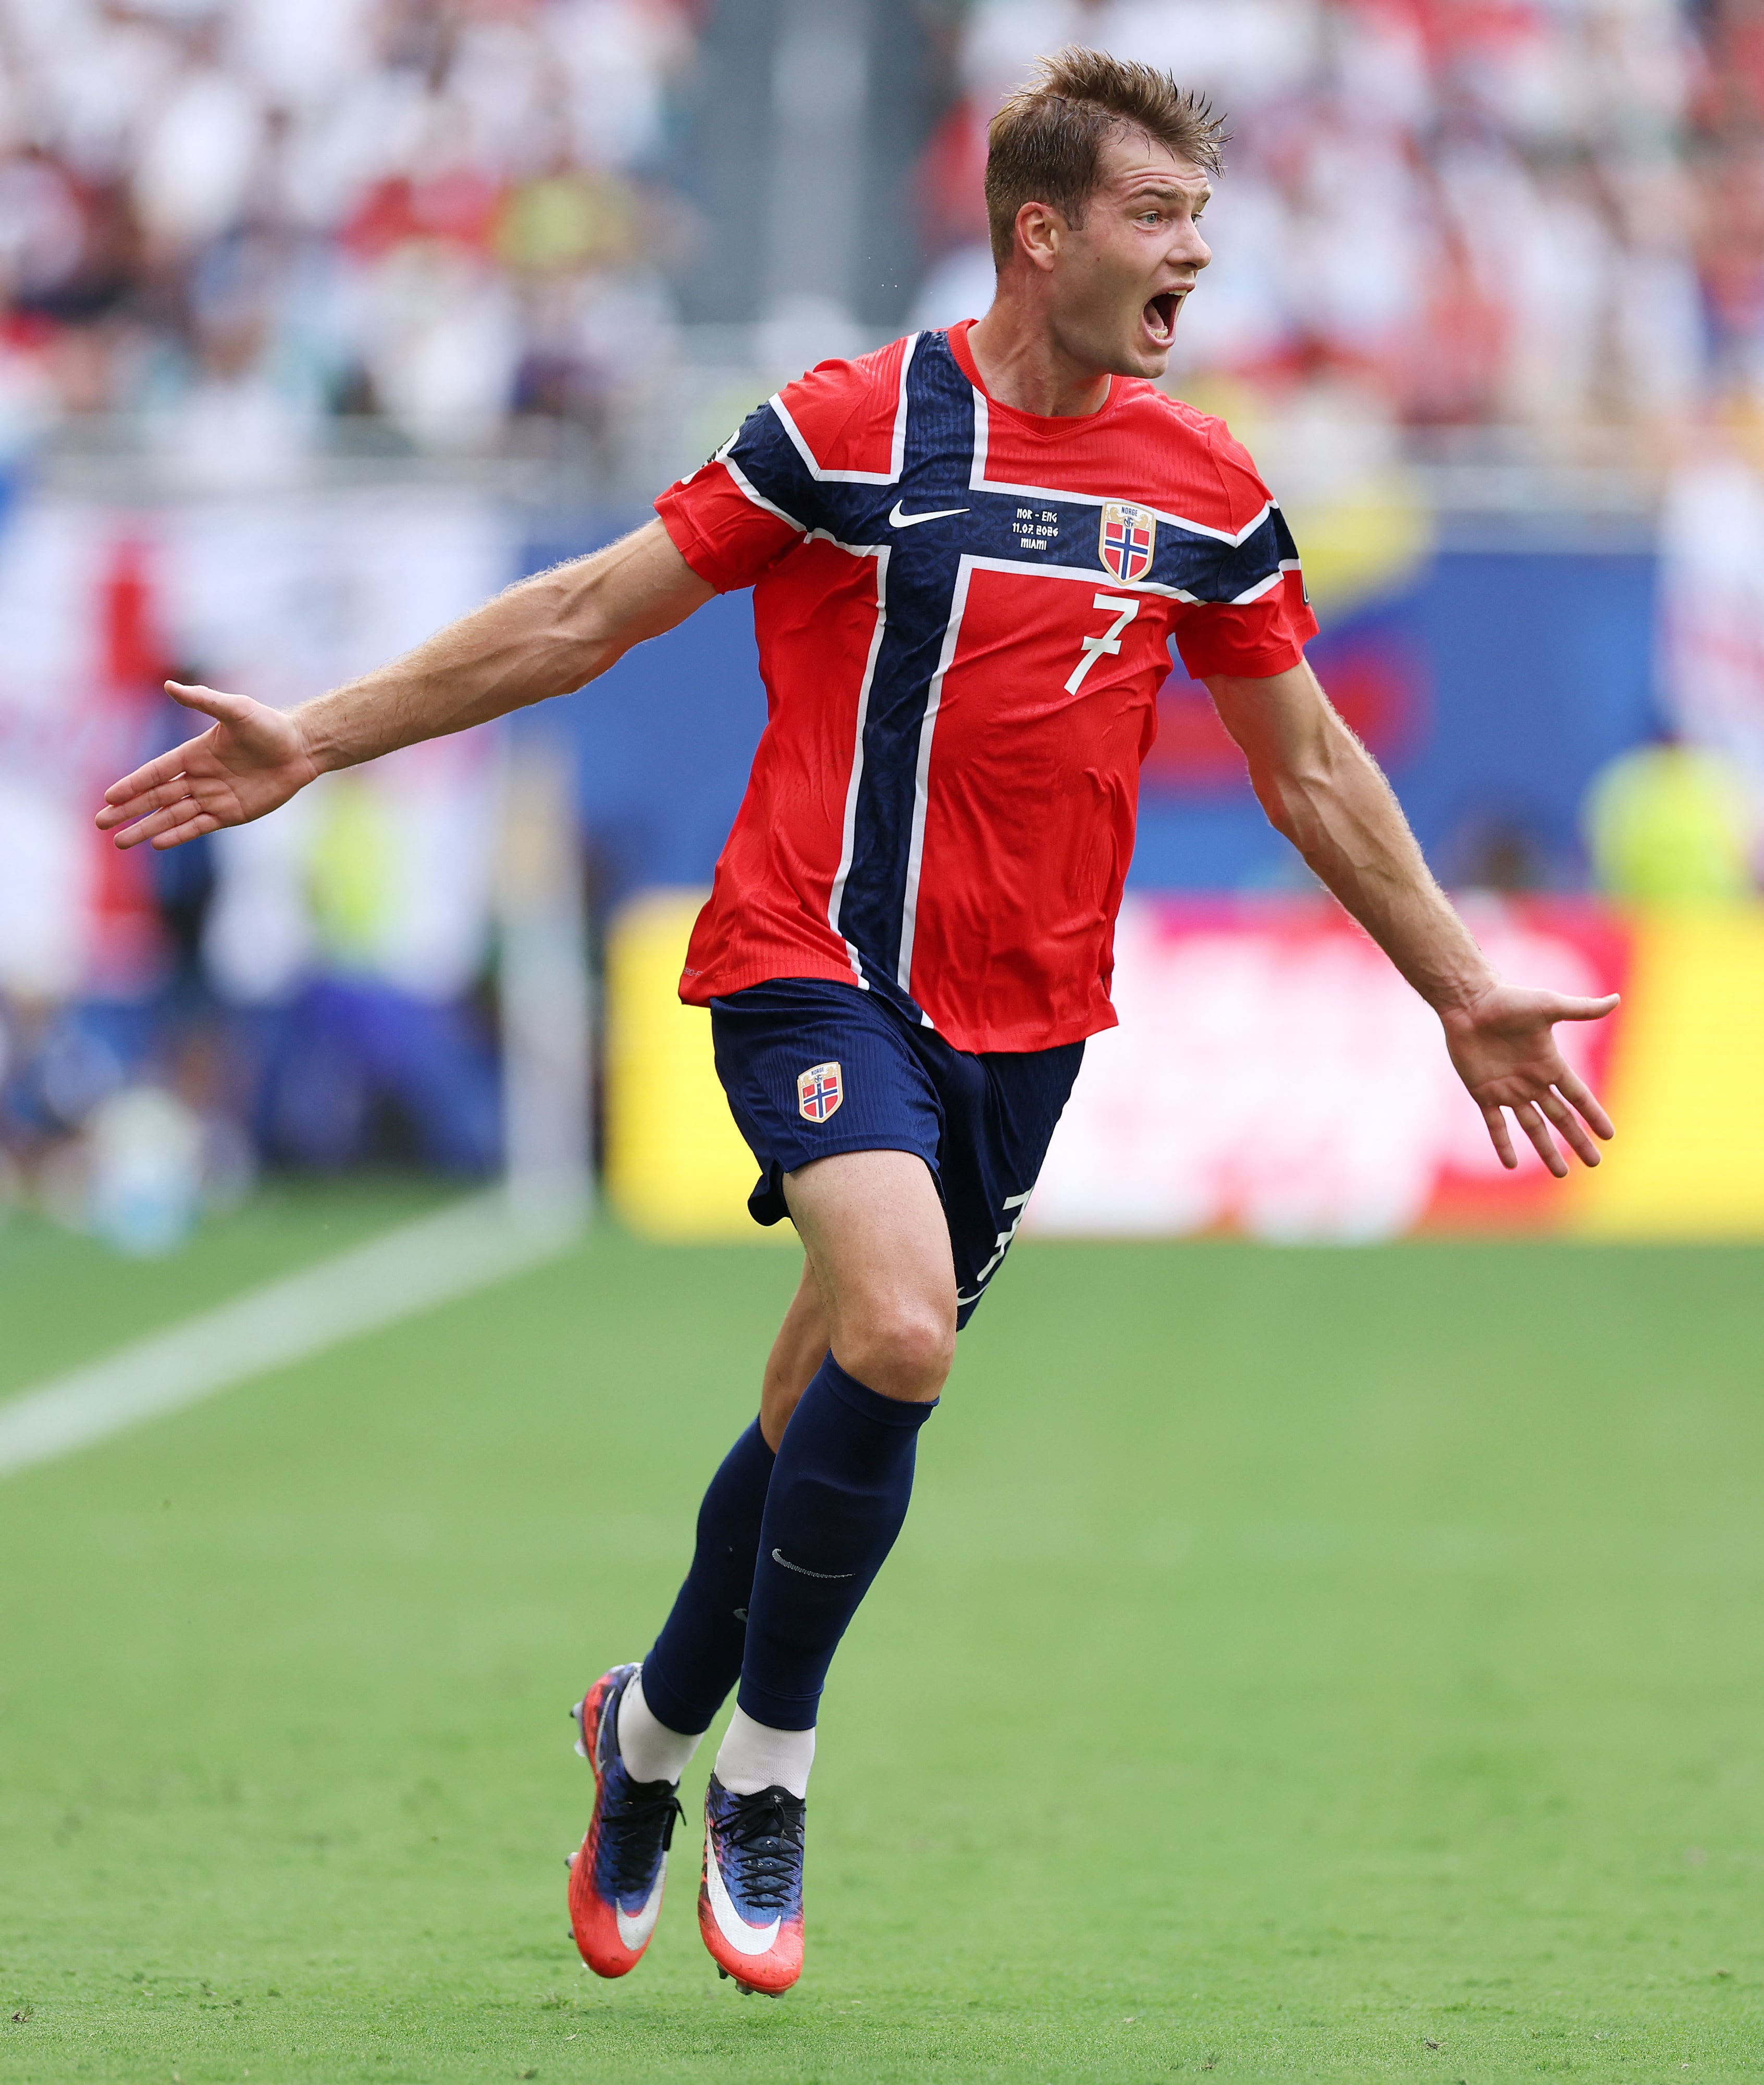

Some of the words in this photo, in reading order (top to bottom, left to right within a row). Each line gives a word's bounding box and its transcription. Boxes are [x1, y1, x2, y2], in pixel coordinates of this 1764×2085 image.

[1016, 508, 1033, 520] NOR
[1041, 511, 1057, 523] ENG
[1121, 506, 1138, 517] NORGE
[1020, 537, 1047, 550] MIAMI
[1064, 593, 1140, 696] 7
[976, 1185, 1034, 1282] 7
